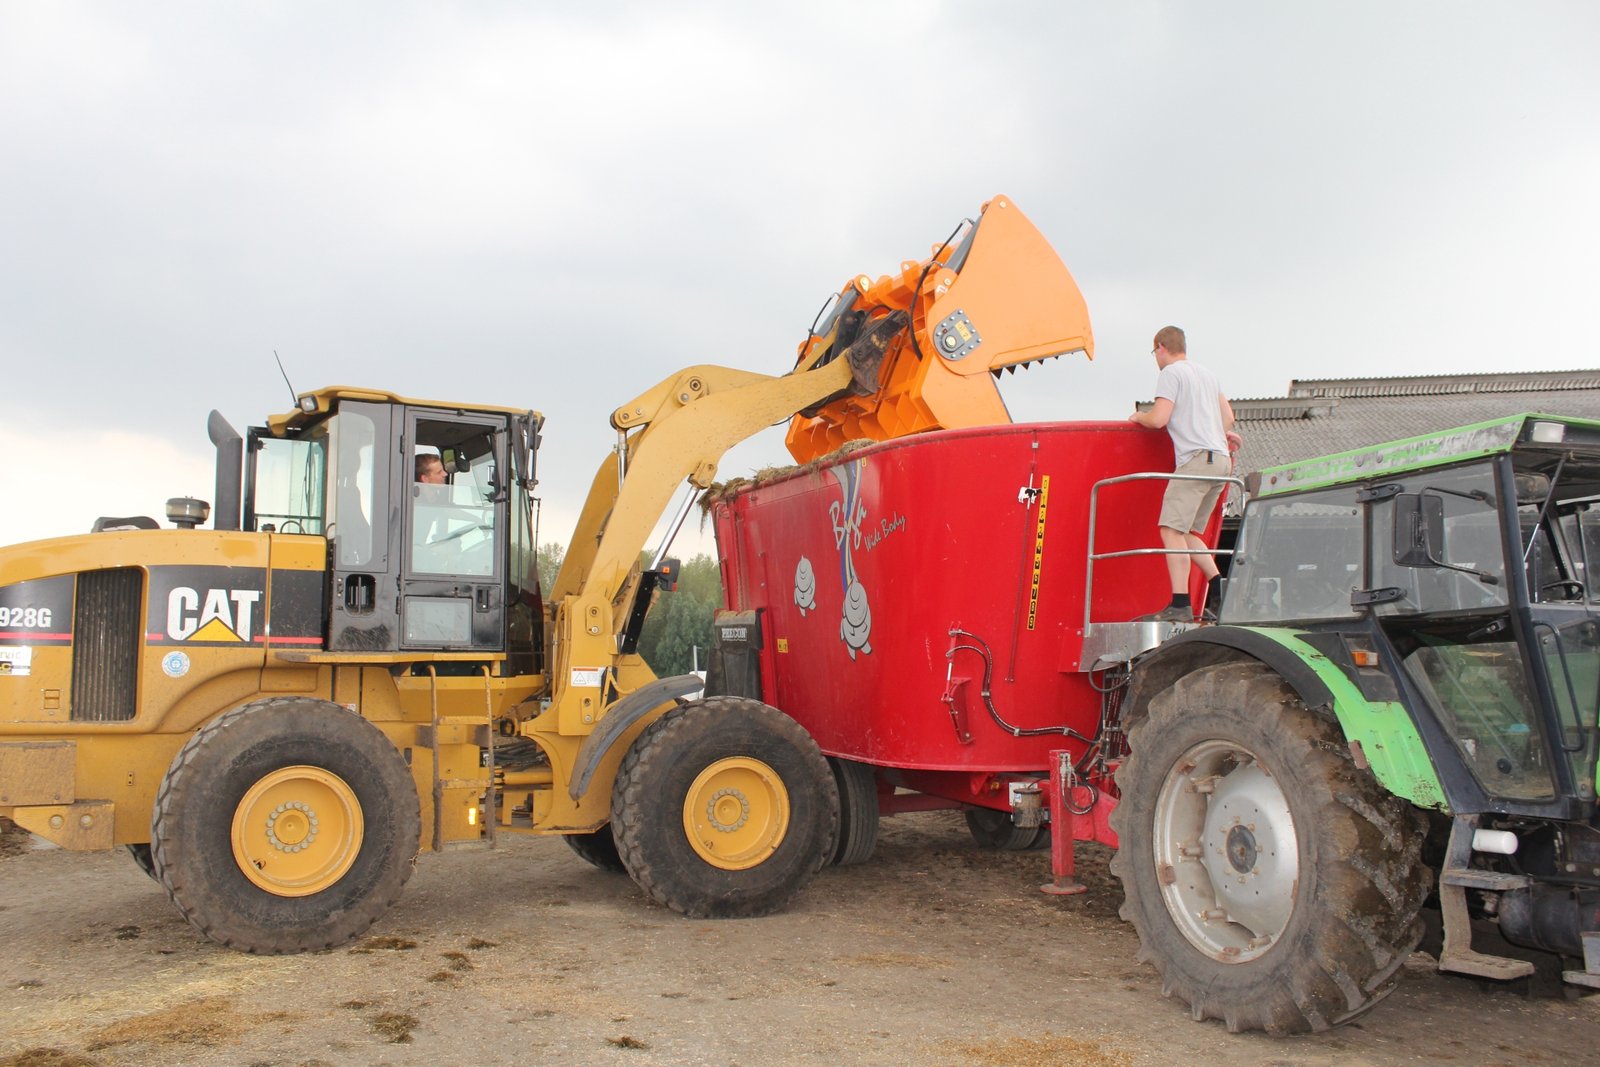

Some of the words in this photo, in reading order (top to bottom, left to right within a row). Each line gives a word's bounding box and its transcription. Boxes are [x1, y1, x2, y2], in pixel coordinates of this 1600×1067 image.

[864, 528, 881, 552] Wide
[881, 511, 906, 539] Body
[0, 606, 52, 628] 928G
[167, 586, 260, 642] CAT
